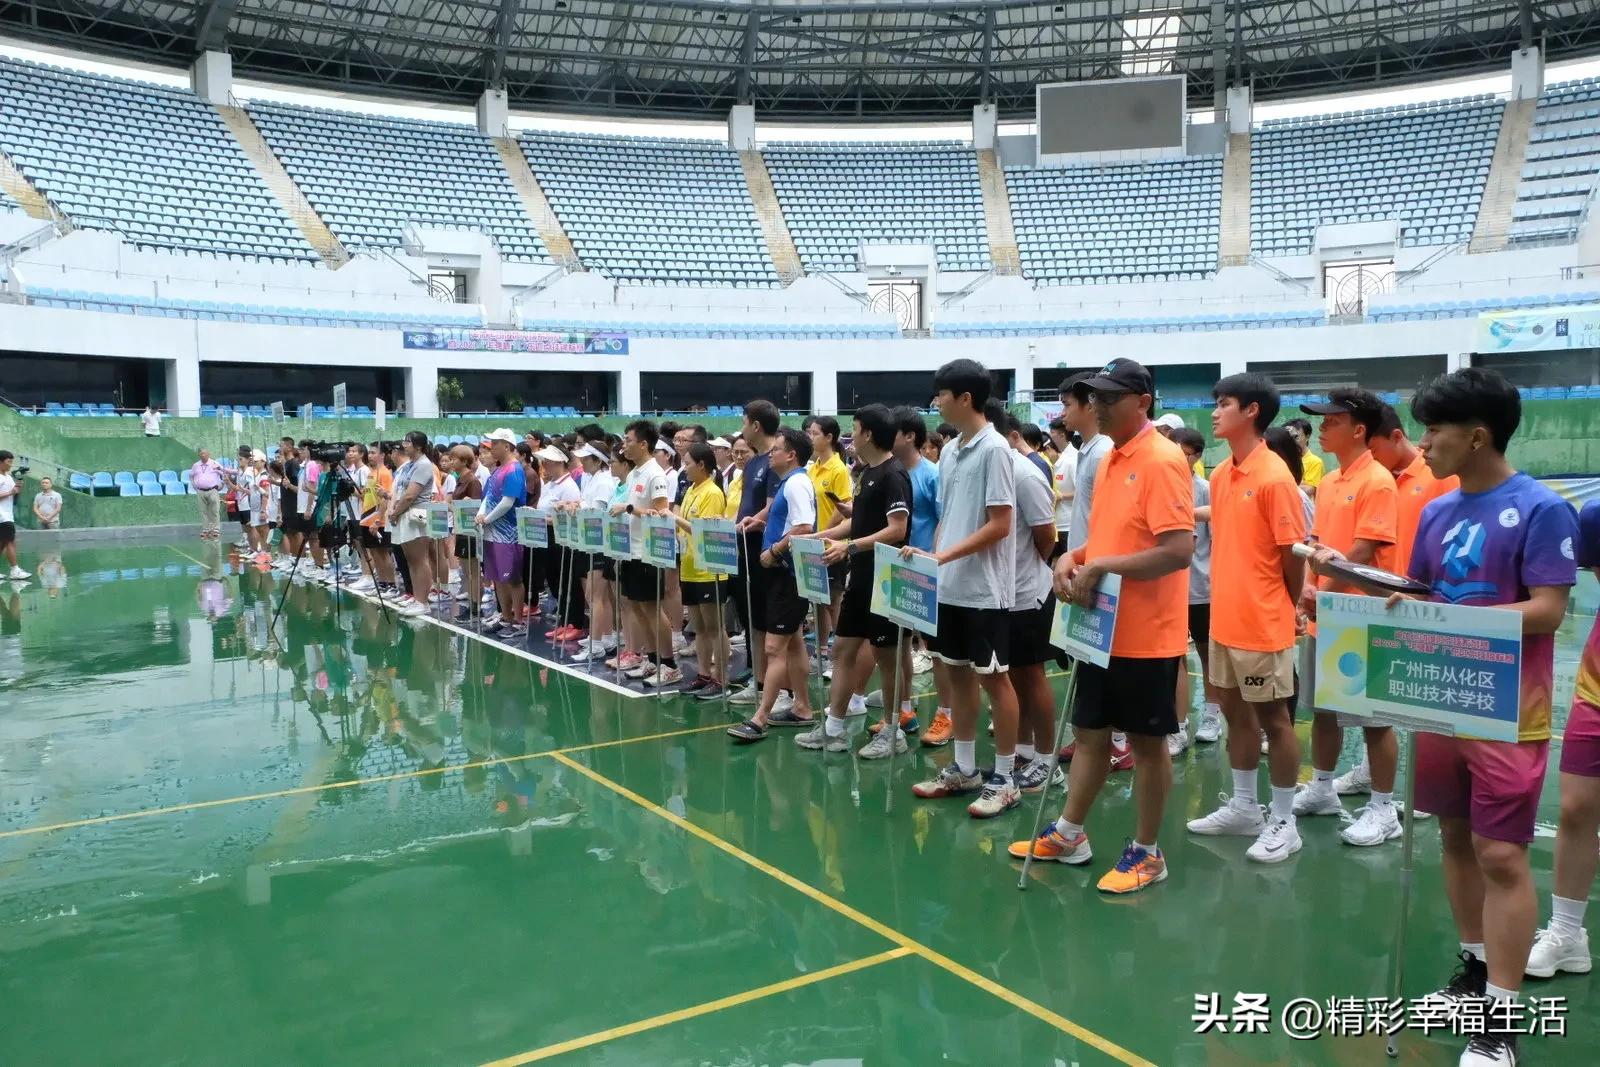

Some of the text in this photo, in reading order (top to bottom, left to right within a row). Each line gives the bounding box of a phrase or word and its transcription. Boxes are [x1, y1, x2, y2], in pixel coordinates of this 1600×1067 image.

[1389, 659, 1496, 690] 广州市从化区
[1388, 679, 1496, 712] 职业技术学校
